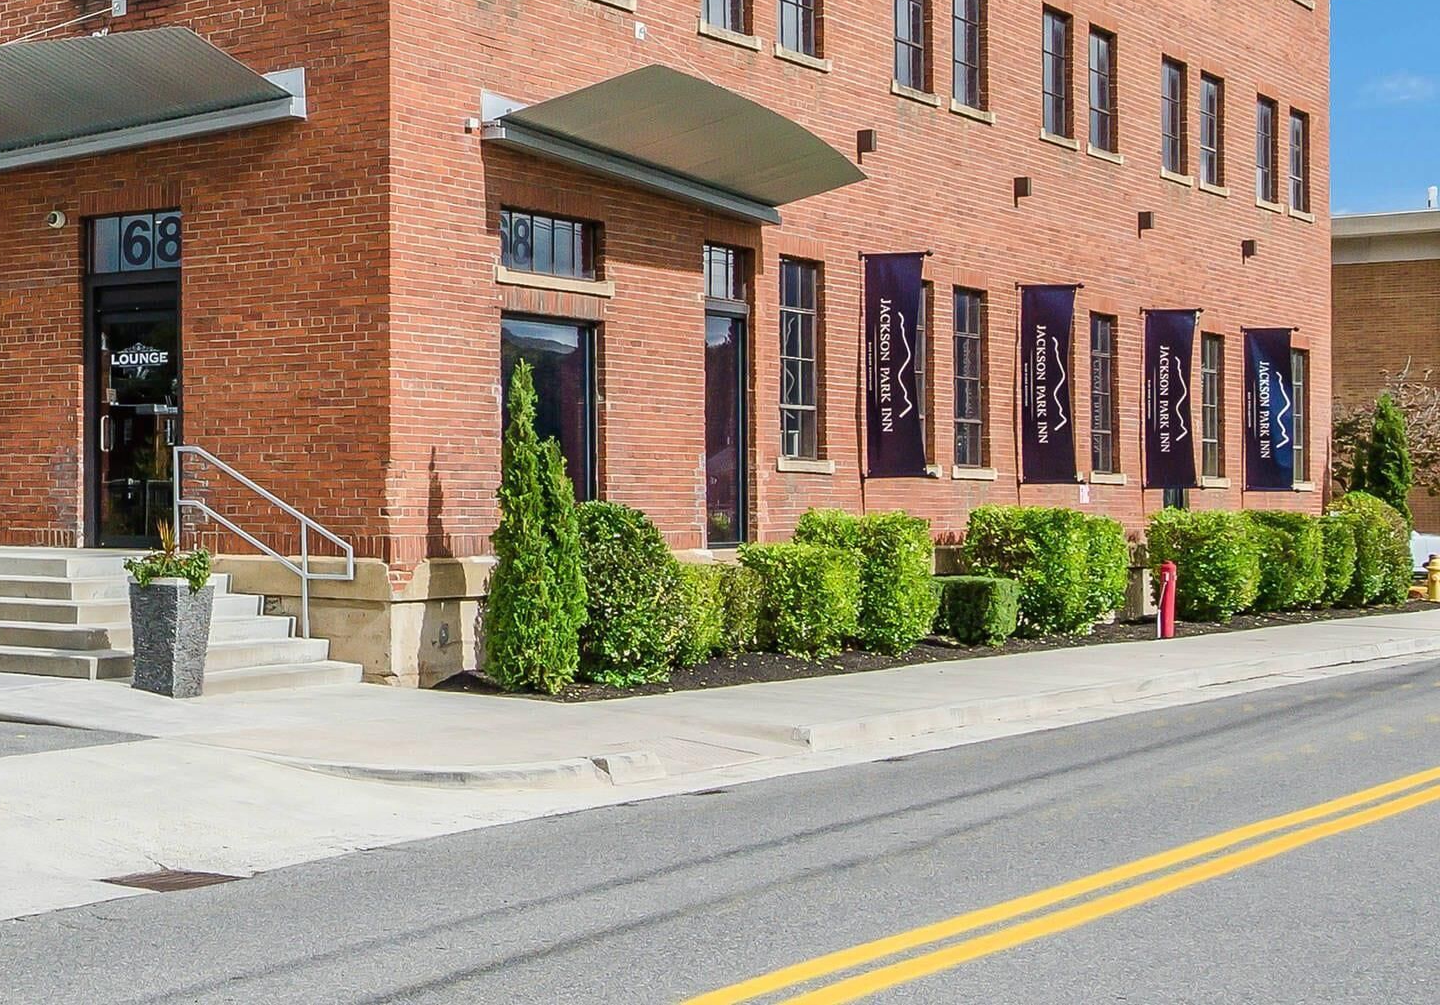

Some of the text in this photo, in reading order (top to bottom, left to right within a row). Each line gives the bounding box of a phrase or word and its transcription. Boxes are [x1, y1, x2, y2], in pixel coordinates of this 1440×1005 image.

[123, 216, 182, 265] 68
[111, 351, 169, 365] LOUNGE
[880, 298, 893, 432] JACKSON PARK INN
[1036, 324, 1049, 443] JACKSON PARK INN
[1159, 345, 1171, 453] JACKSON PARK INN
[1259, 361, 1271, 459] JACKSON PARK INN
